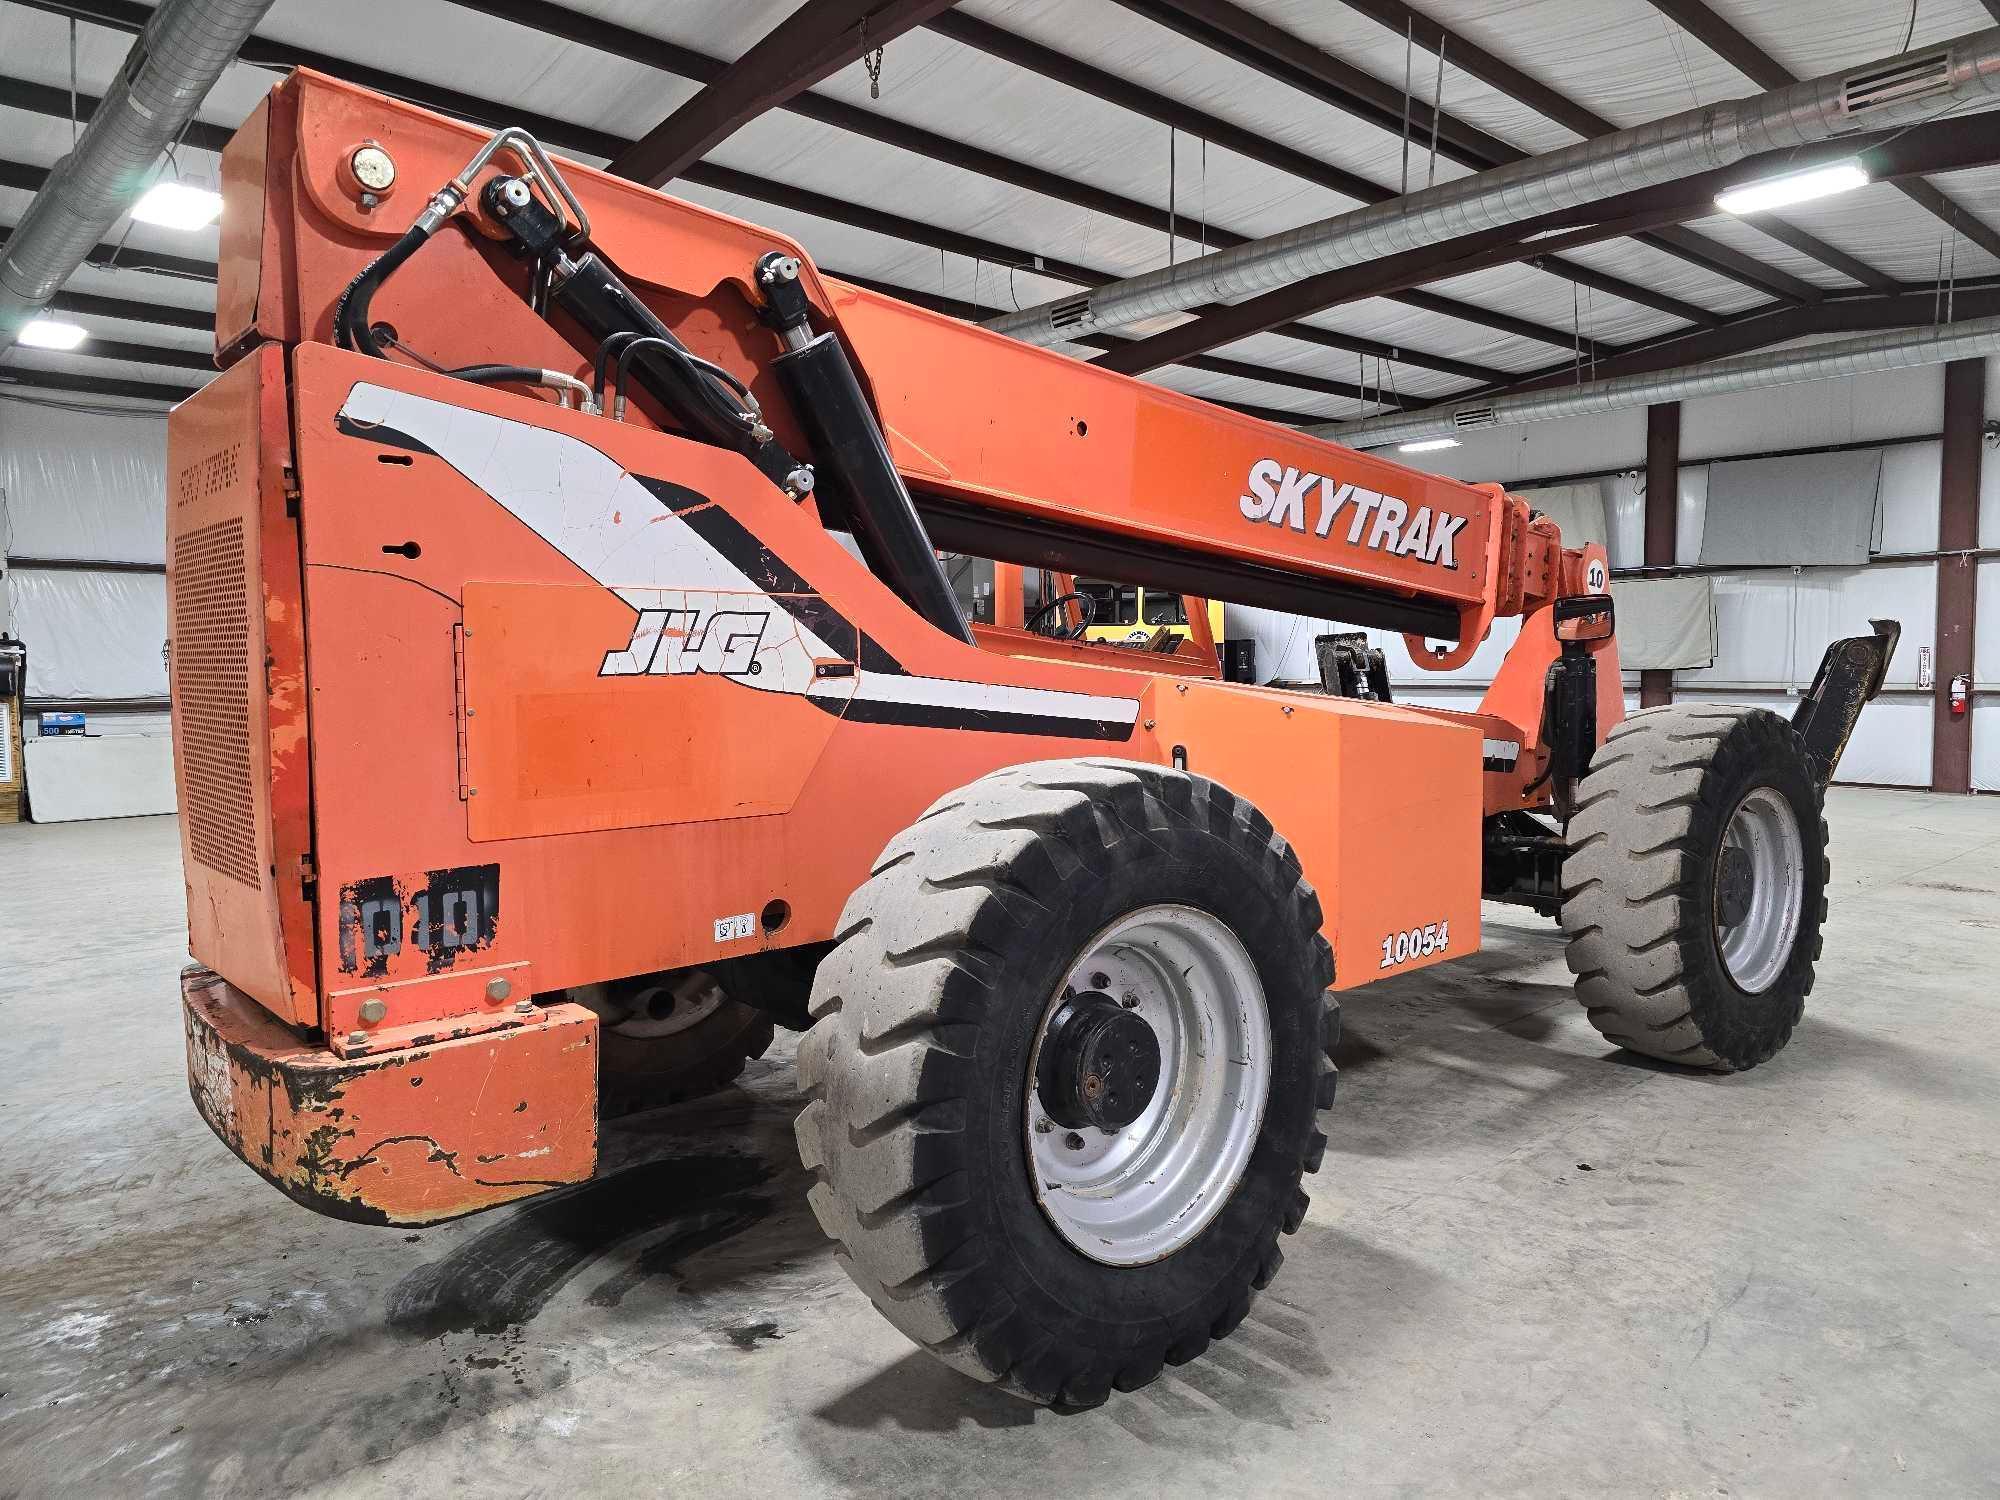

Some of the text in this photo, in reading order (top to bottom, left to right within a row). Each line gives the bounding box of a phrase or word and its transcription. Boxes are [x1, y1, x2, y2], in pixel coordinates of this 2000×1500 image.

[1239, 458, 1467, 570] SKYTRAK
[1589, 567, 1604, 589] 10
[598, 608, 770, 676] JLG
[1380, 920, 1449, 969] 10054
